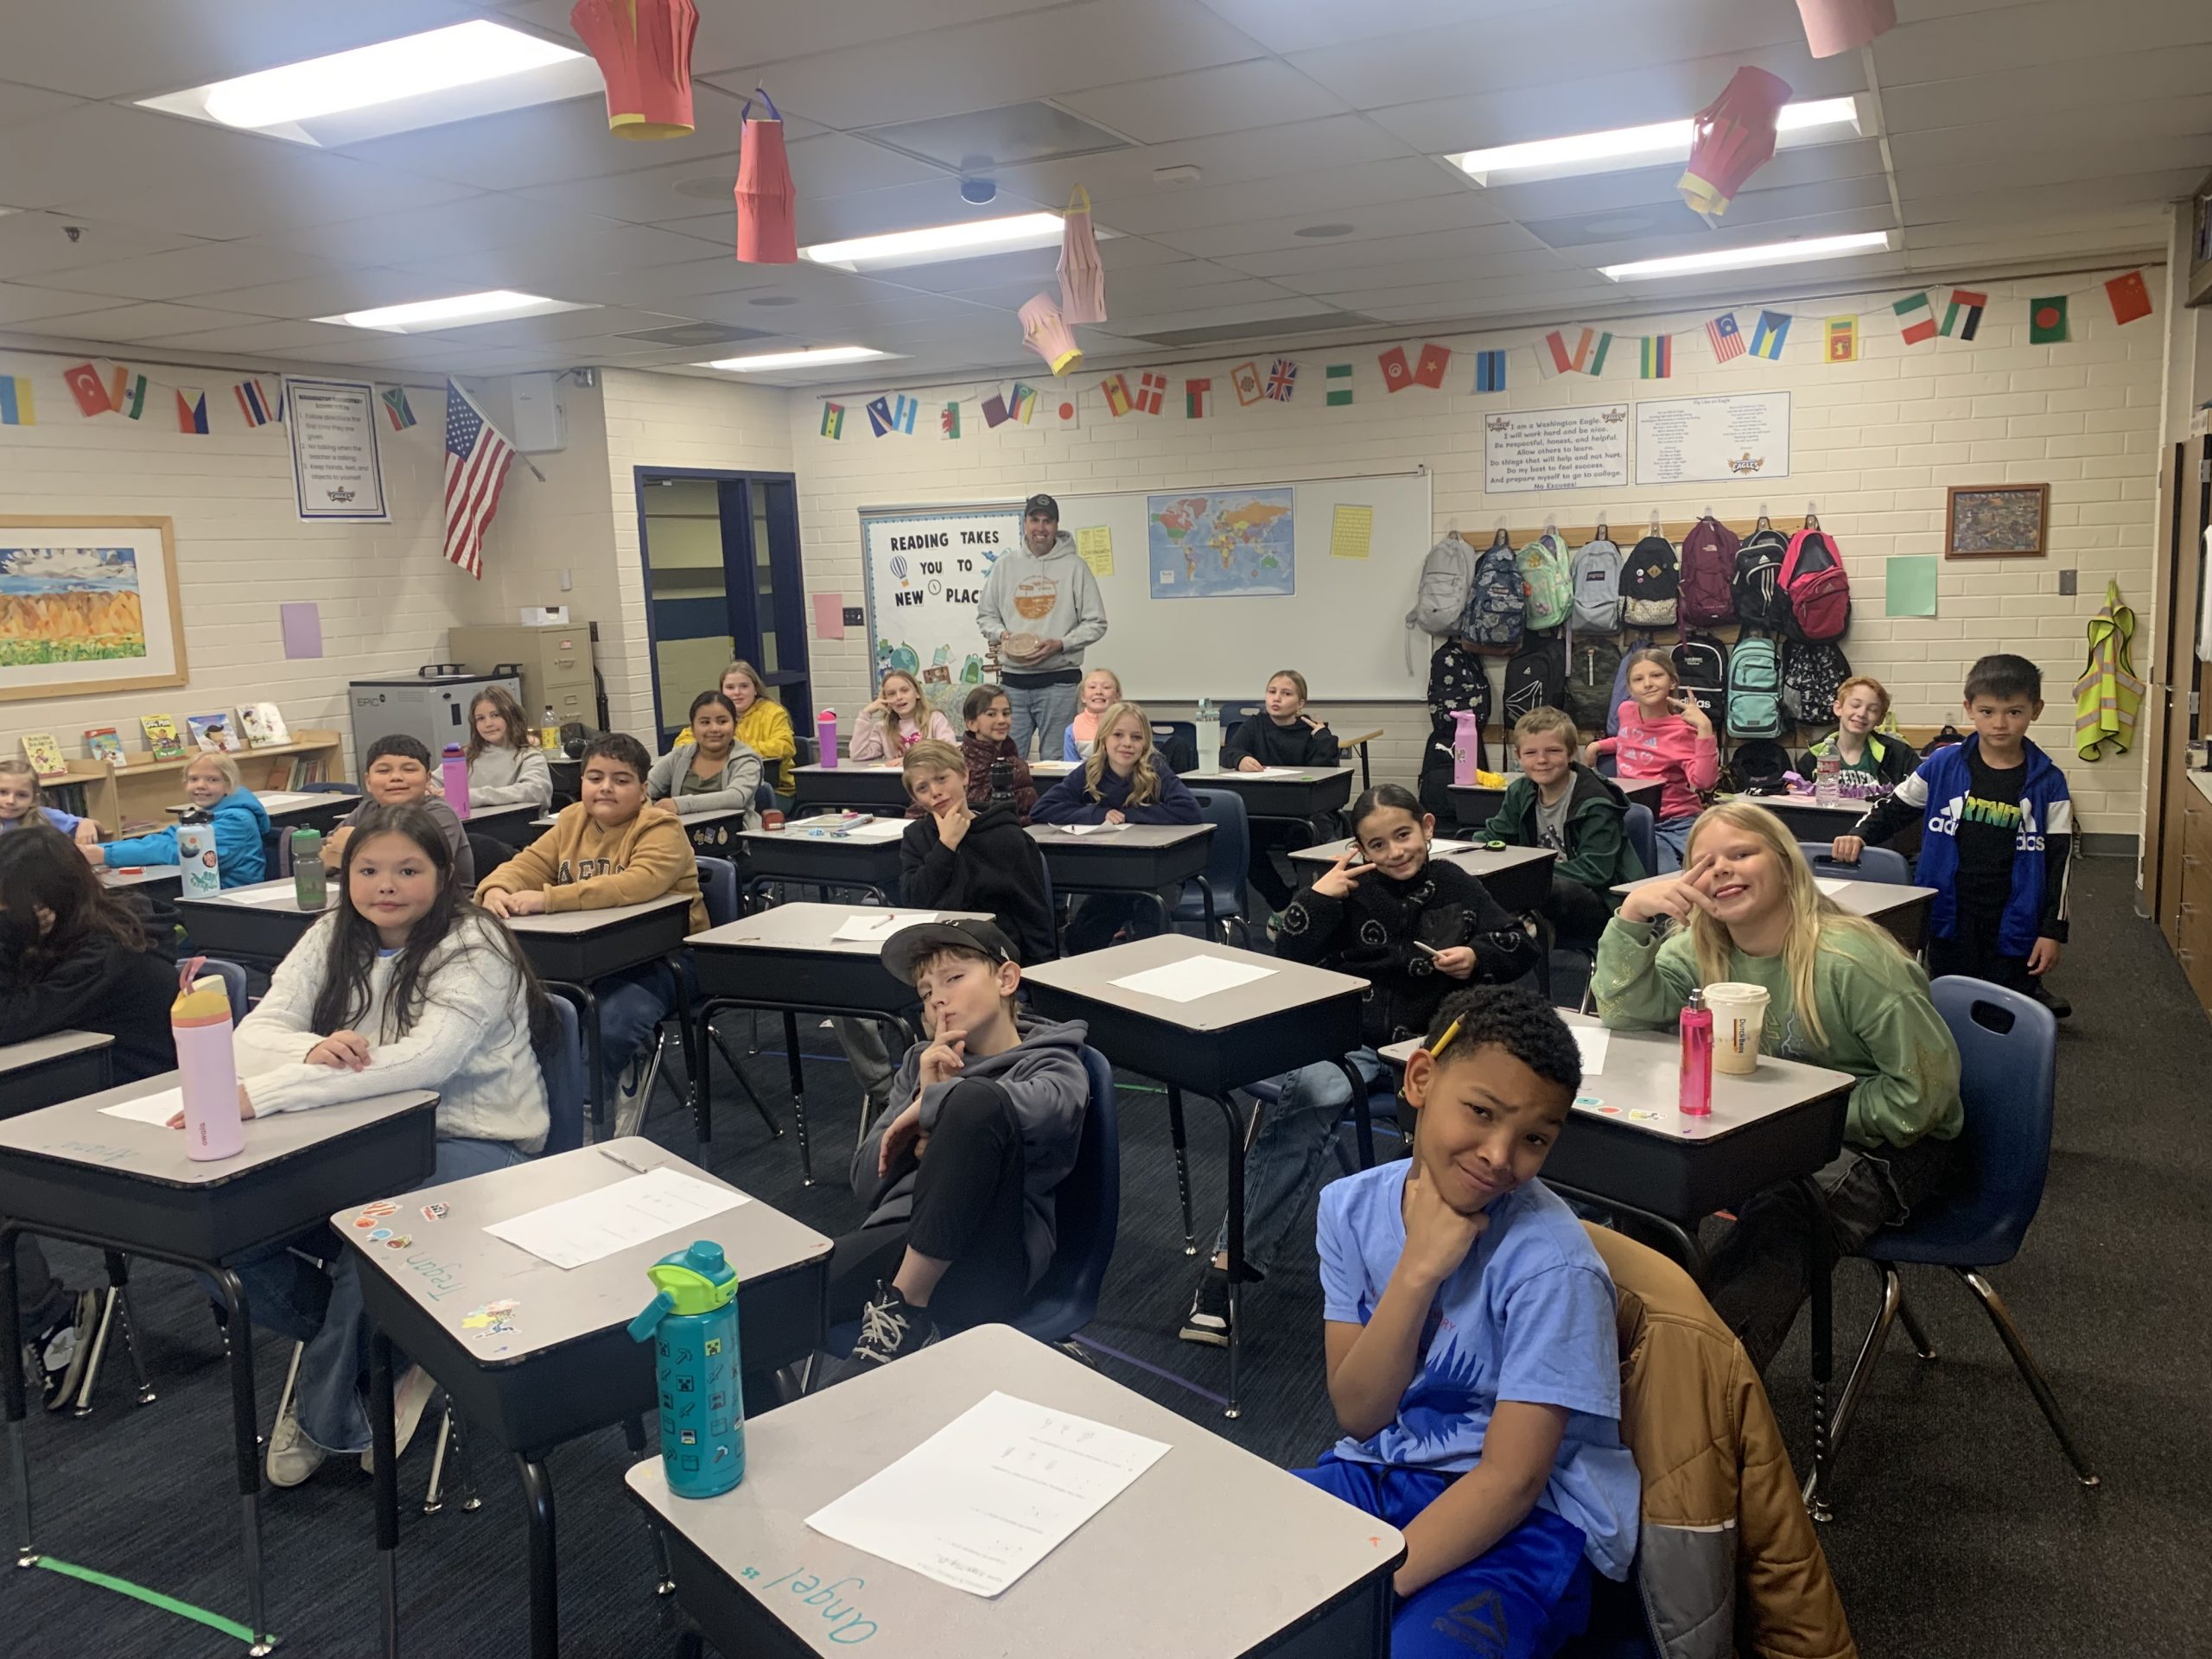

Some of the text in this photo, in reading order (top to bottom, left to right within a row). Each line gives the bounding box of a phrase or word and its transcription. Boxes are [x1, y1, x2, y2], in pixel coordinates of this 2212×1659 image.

[1536, 420, 1577, 429] Washington
[1502, 458, 1523, 467] things
[1732, 462, 1760, 472] EAGLES
[890, 531, 999, 551] READING TAKES
[919, 559, 972, 575] YOU TO
[895, 588, 982, 607] NEW PLAC
[357, 697, 379, 707] EPIC
[1962, 796, 2021, 830] RTNIT
[198, 1122, 208, 1146] owala
